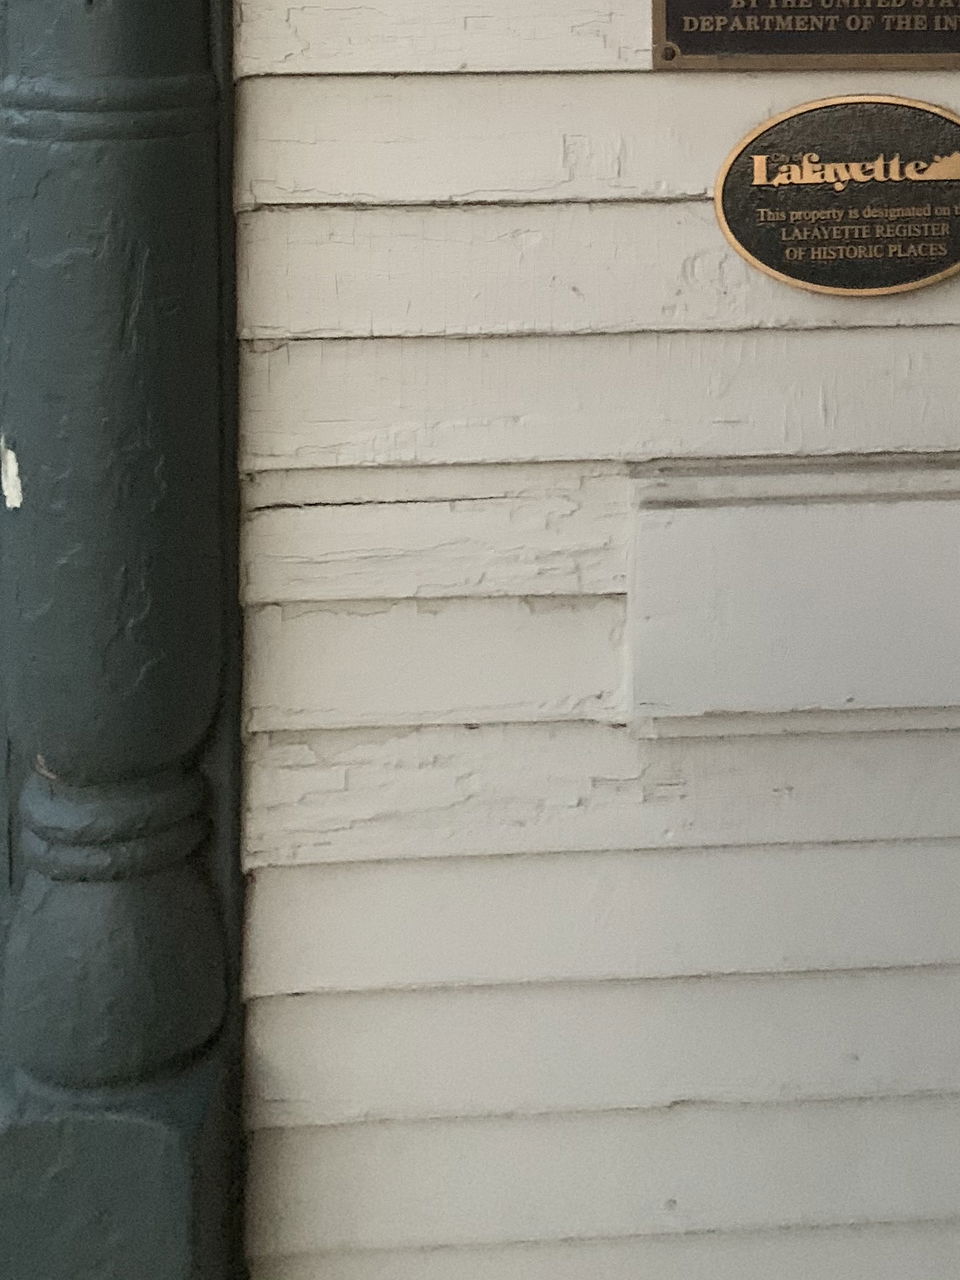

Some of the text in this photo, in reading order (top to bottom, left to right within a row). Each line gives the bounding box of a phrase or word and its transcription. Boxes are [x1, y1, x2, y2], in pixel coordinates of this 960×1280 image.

[683, 15, 839, 32] DEPARTMENT
[846, 15, 875, 32] OF
[881, 15, 927, 32] THE
[750, 152, 929, 192] Lafayette
[757, 208, 786, 222] This
[790, 207, 844, 224] property
[848, 207, 860, 220] is
[862, 205, 931, 223] designated
[935, 207, 951, 217] on
[781, 223, 950, 242] LAFAYETTE REGISTER
[785, 242, 948, 262] OF HISTORIC PLACES
